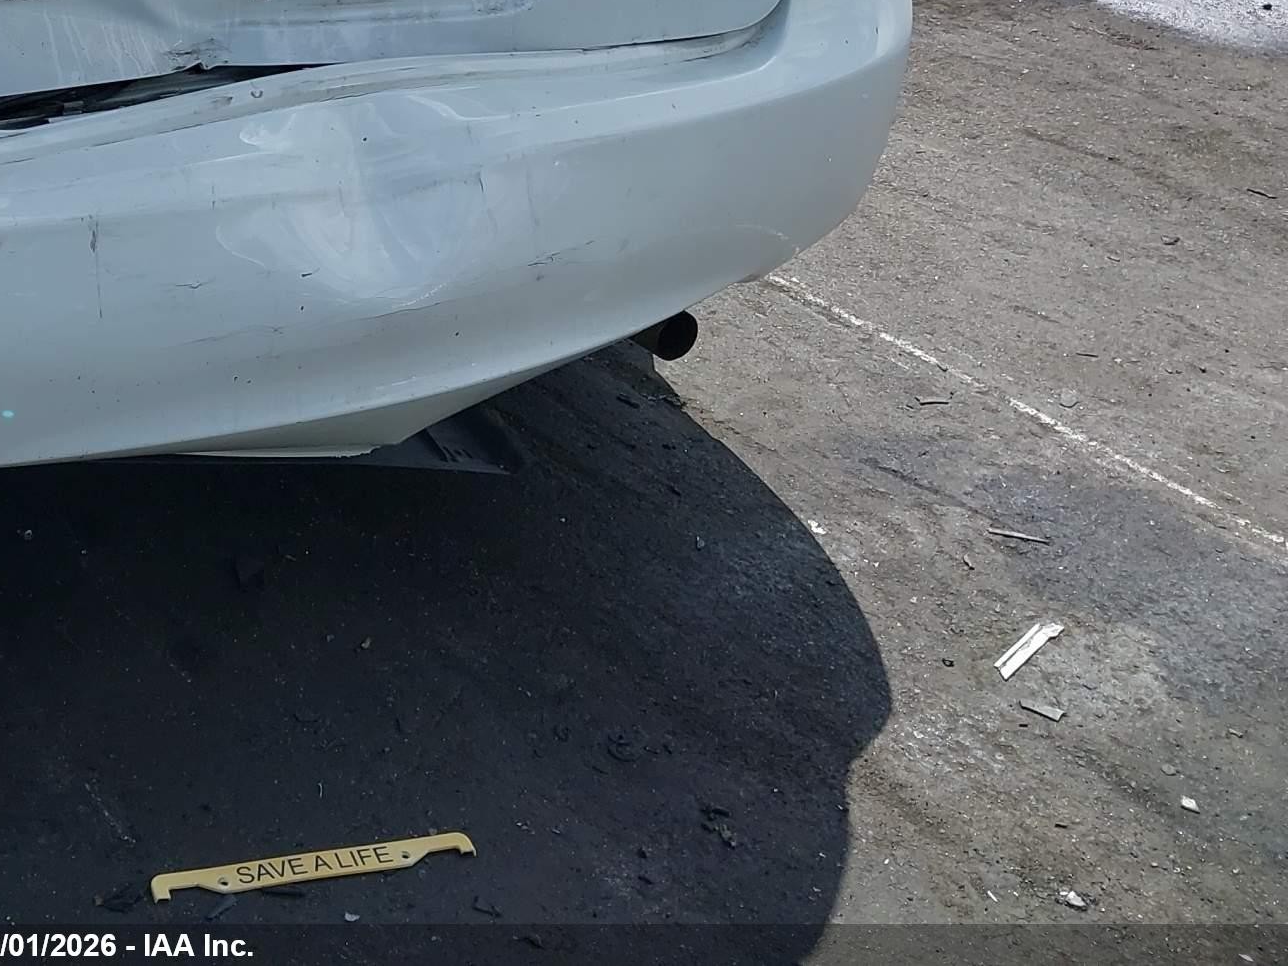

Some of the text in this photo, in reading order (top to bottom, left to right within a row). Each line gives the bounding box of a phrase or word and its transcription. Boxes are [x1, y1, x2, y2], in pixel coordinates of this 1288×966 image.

[236, 846, 394, 884] SAVE A LIFE
